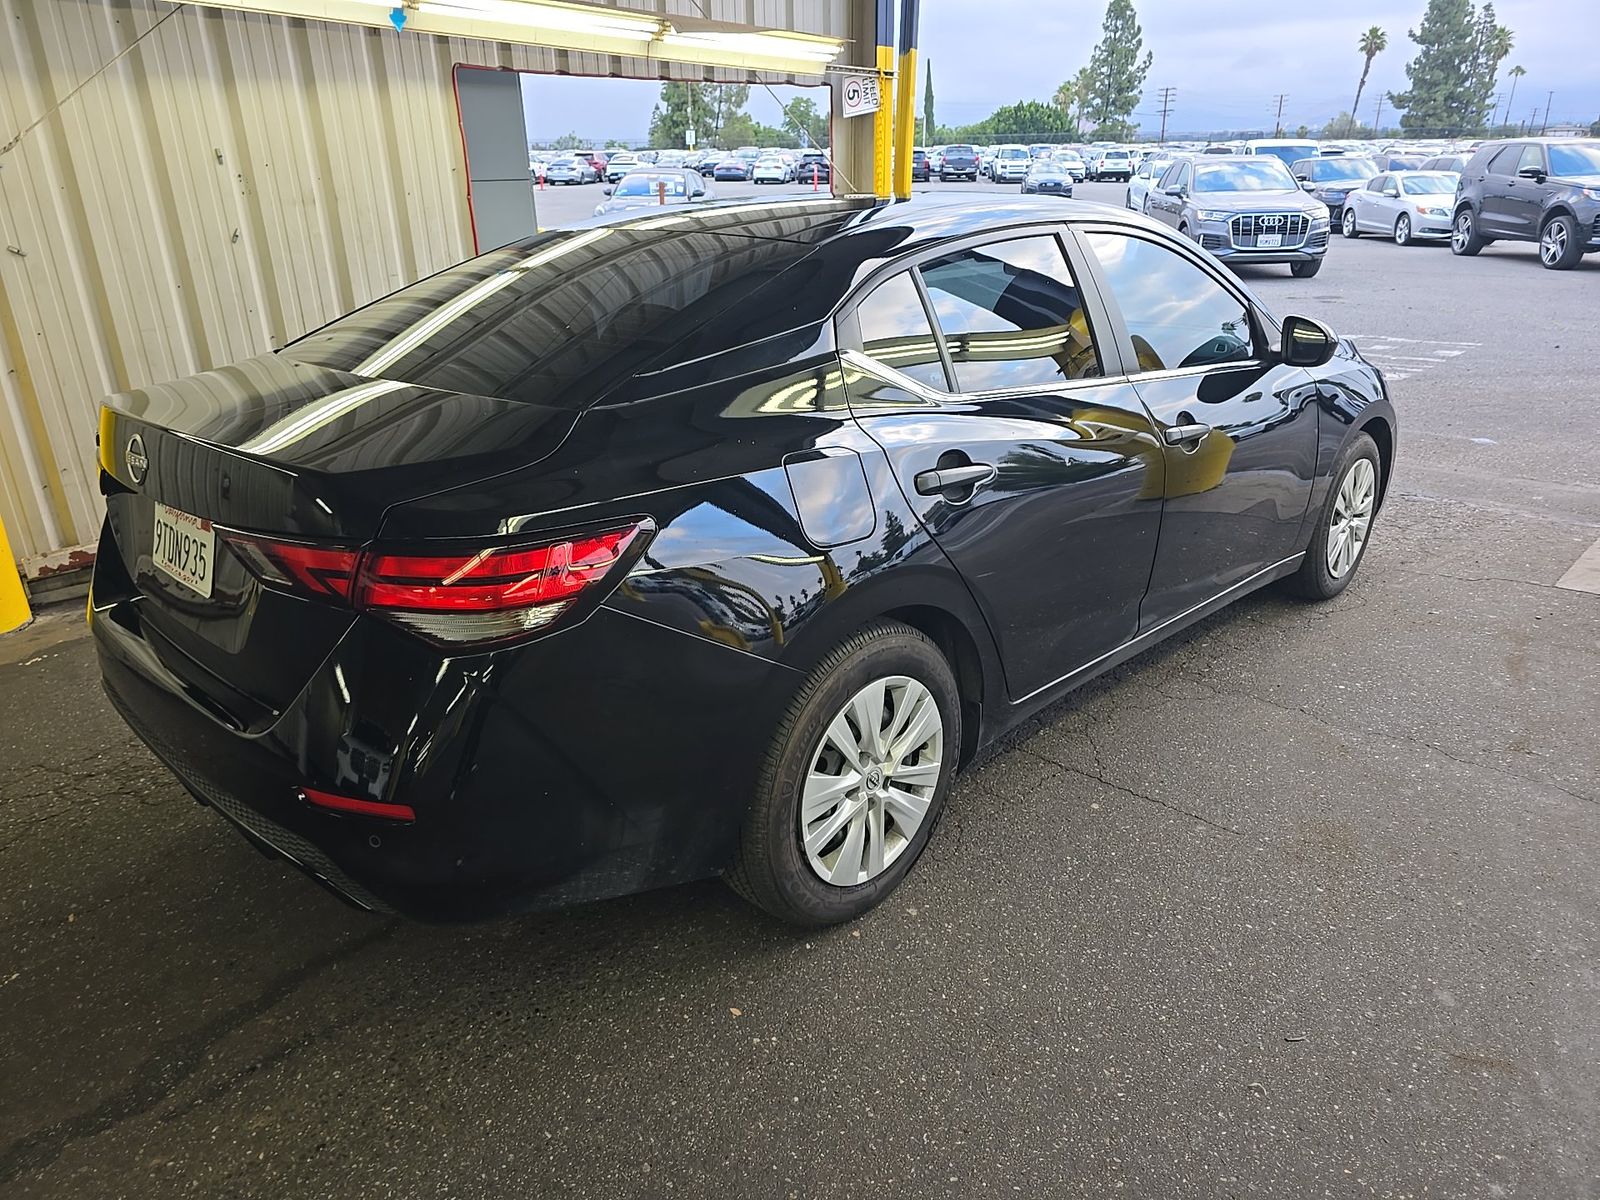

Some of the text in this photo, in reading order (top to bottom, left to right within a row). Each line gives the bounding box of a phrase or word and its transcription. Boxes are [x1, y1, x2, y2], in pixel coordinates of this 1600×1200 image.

[847, 88, 860, 101] 5
[862, 77, 871, 105] LIMIT
[868, 77, 879, 106] PEED
[154, 518, 207, 582] 9TDN935
